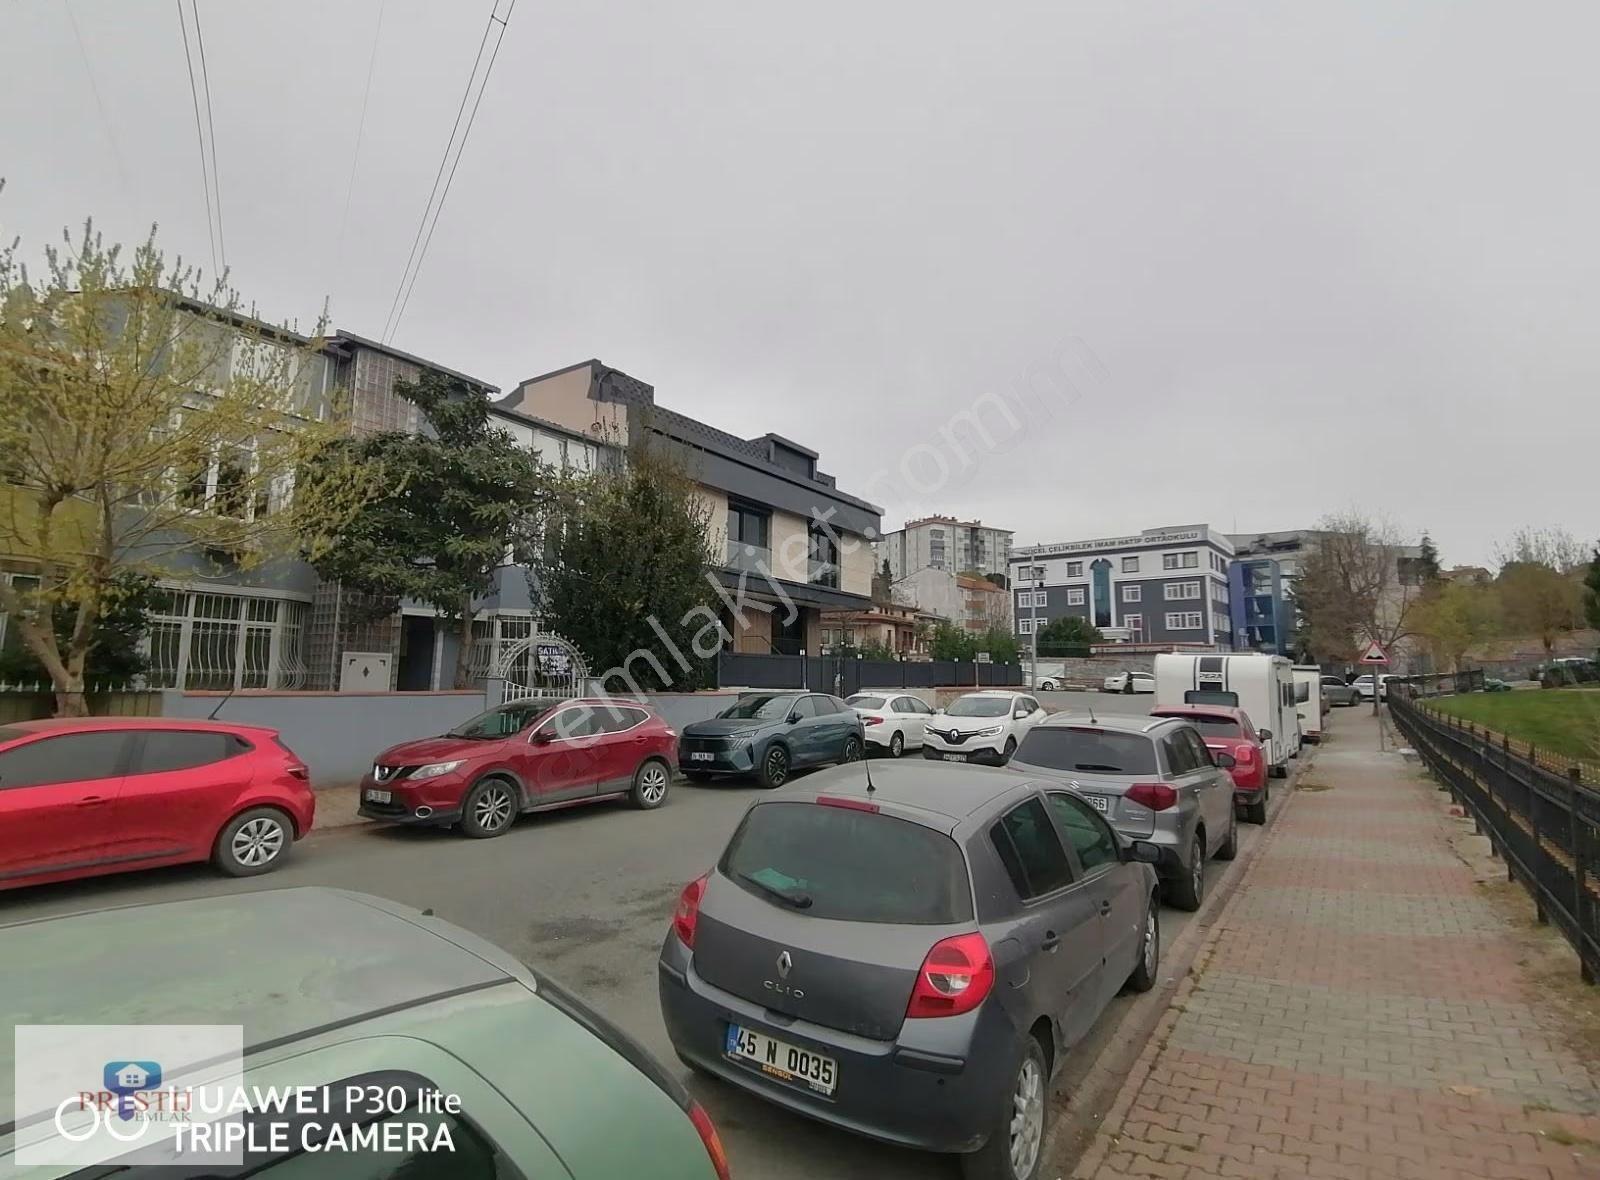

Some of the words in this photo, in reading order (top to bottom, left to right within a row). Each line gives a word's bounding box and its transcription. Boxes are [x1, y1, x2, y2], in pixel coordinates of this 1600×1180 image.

[538, 646, 564, 655] SATIL
[764, 980, 804, 998] CLIO
[736, 1030, 757, 1056] 45
[766, 1039, 778, 1064] N
[787, 1048, 833, 1085] 0035
